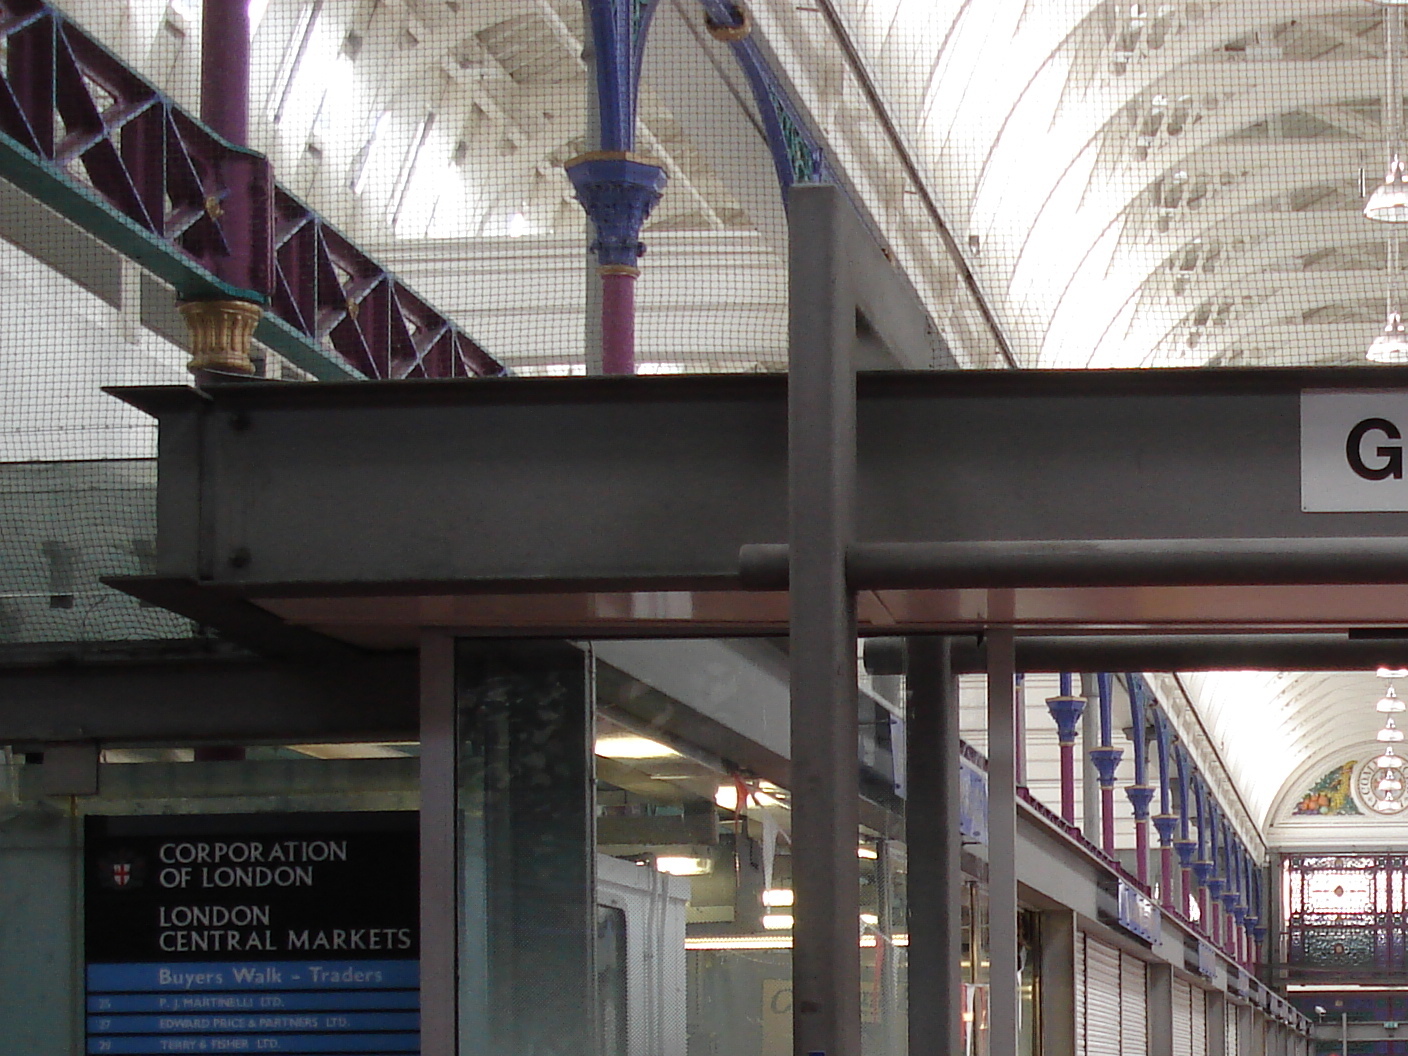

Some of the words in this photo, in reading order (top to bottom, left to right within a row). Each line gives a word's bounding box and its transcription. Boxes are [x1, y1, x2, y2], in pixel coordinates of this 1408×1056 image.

[159, 841, 348, 864] CORPORATION
[159, 867, 192, 888] OF
[202, 866, 314, 888] LONDON
[159, 905, 270, 927] LONDON
[159, 930, 277, 952] CENTRAL
[288, 929, 412, 950] MARKETS
[159, 968, 223, 989] Buyers
[232, 966, 282, 984] Walk
[309, 966, 383, 983] Traders
[159, 1019, 210, 1029] EDWARD
[213, 1018, 246, 1028] PRICE
[259, 1018, 318, 1028] PARTNERS
